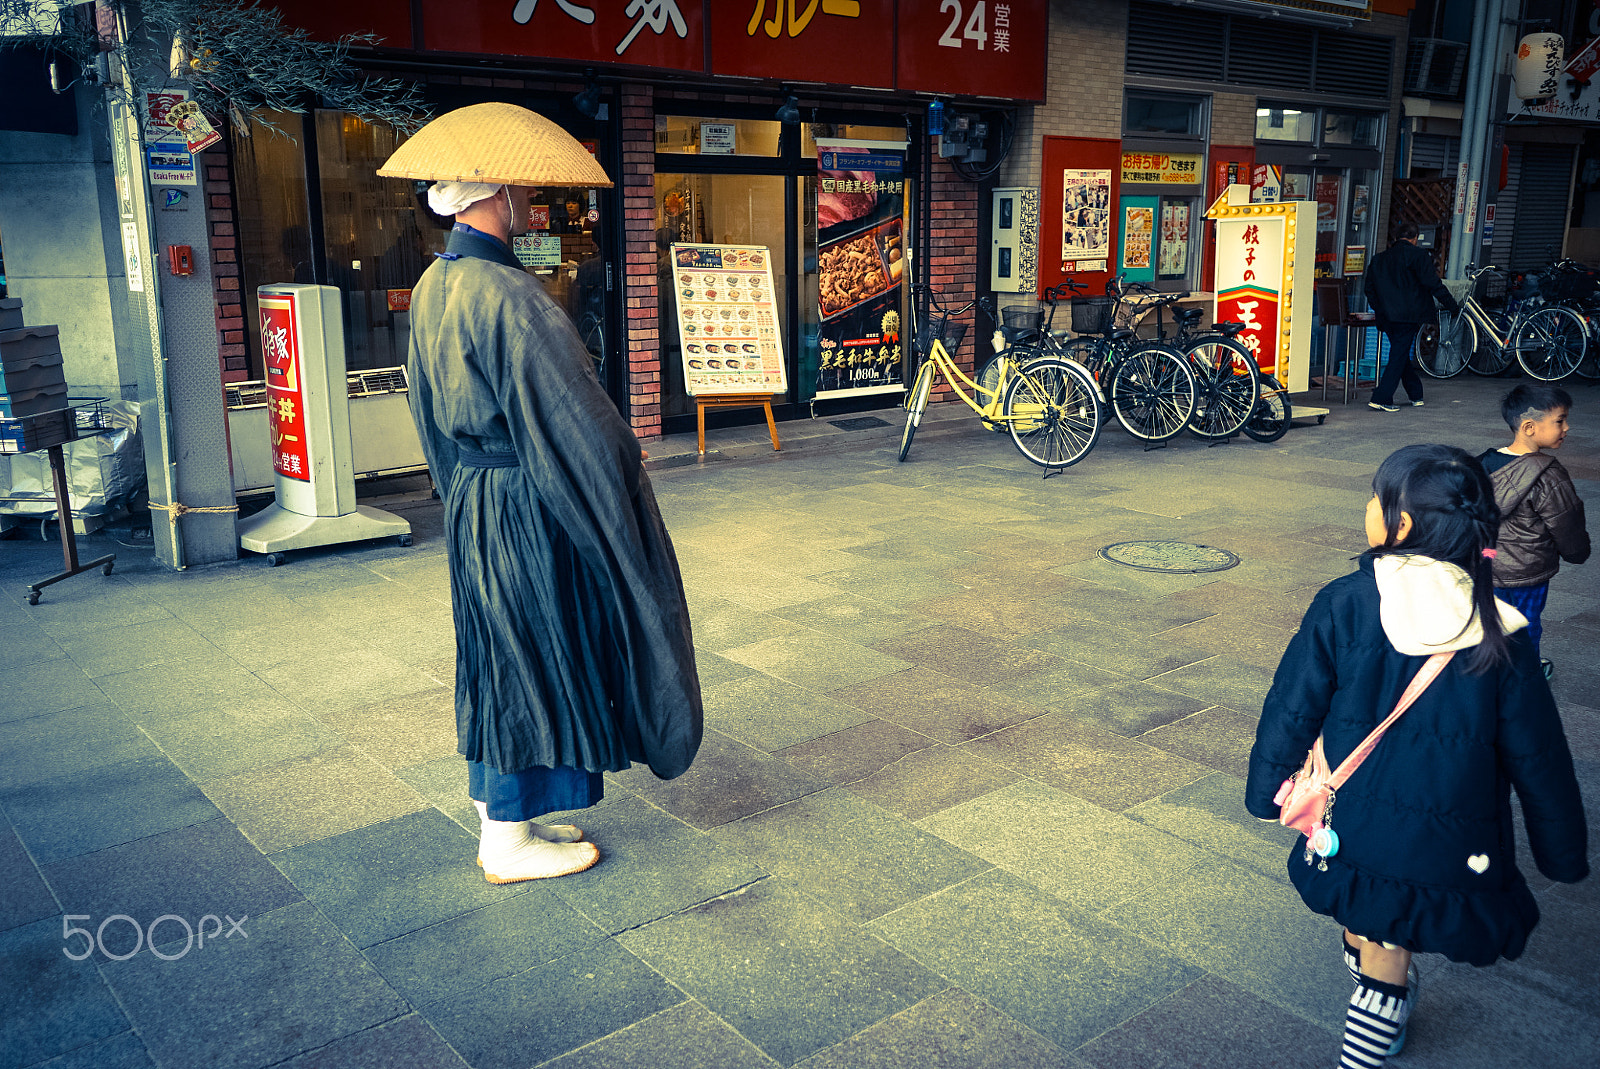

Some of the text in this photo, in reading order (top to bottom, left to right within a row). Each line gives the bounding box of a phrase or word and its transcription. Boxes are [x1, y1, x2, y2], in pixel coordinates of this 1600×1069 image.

[938, 0, 996, 58] 24
[1003, 3, 1021, 53] 営業
[836, 180, 903, 194] 国産黒毛和牛使用
[1241, 224, 1260, 282] 餃子の
[262, 312, 290, 365] すき家
[819, 344, 902, 371] 黒毛和牛弁当
